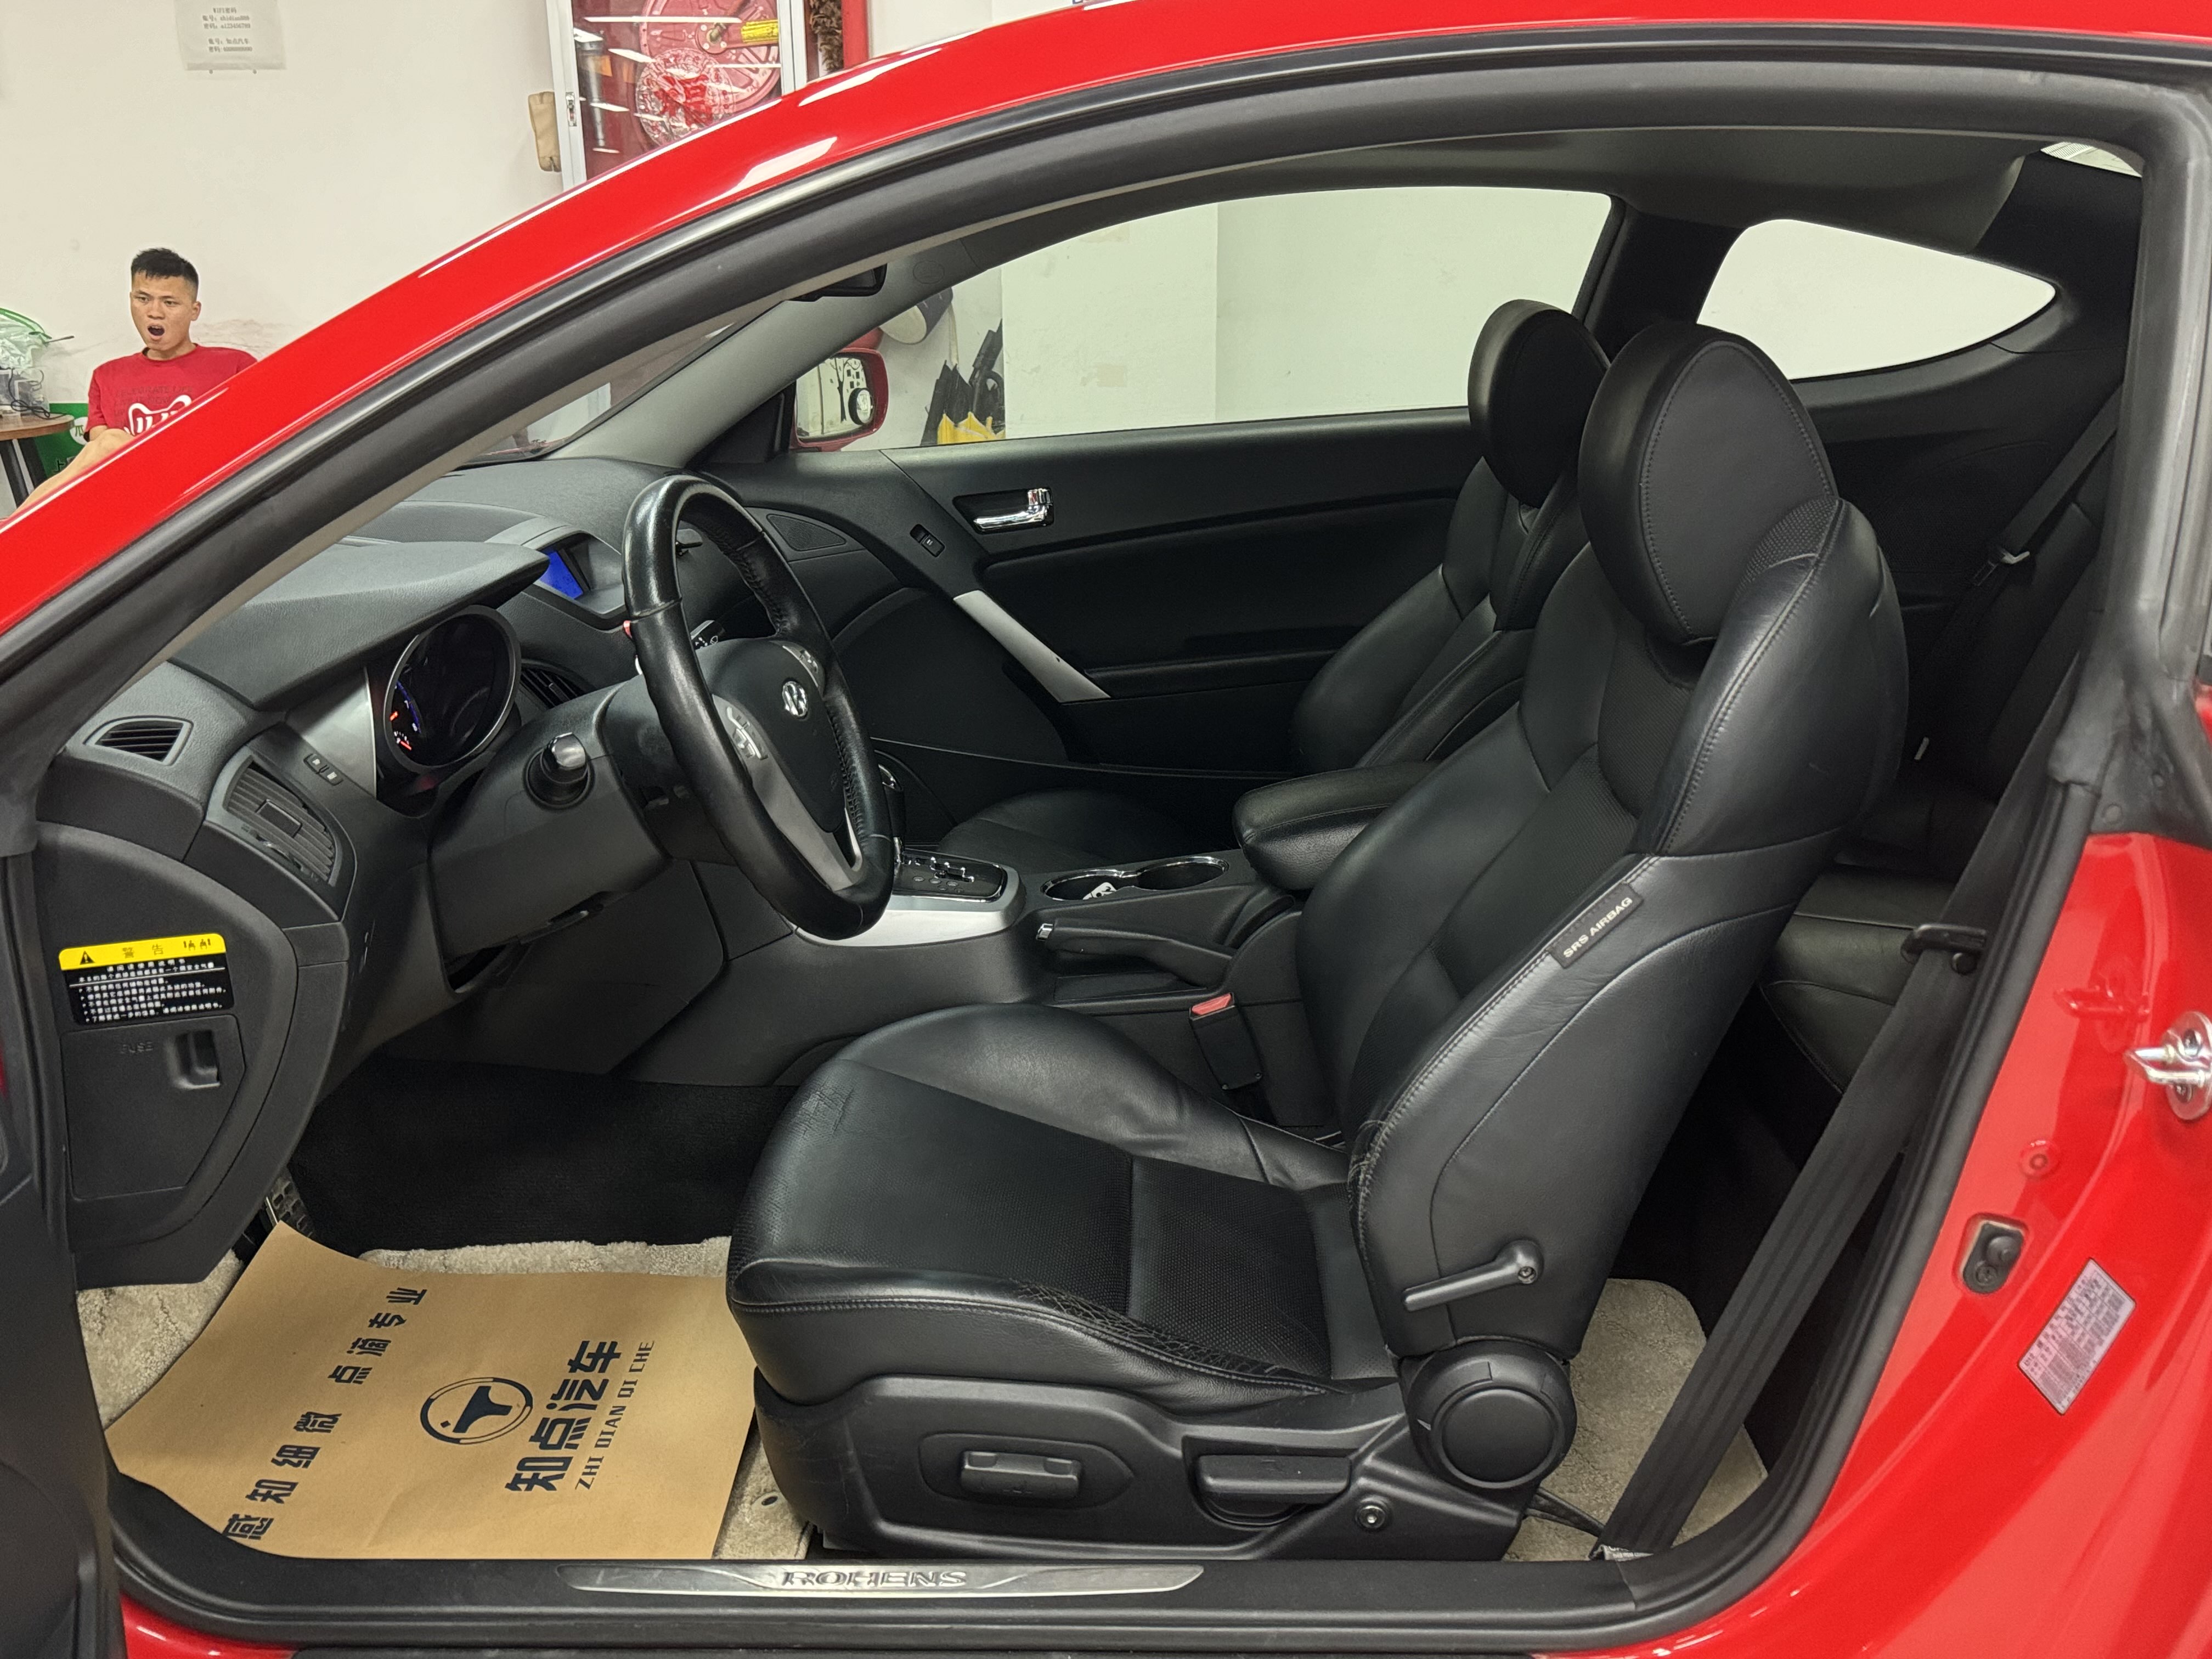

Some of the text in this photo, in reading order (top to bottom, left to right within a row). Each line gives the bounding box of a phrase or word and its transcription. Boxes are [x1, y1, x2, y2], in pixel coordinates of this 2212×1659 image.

[1564, 897, 1633, 958] SRS AIRBAG
[222, 1286, 428, 1540] 感知细微 点滴专业
[505, 1340, 622, 1492] 知点汽车
[575, 1341, 654, 1490] ZHI DIAN QI CHE
[781, 1571, 967, 1588] ROHENS
